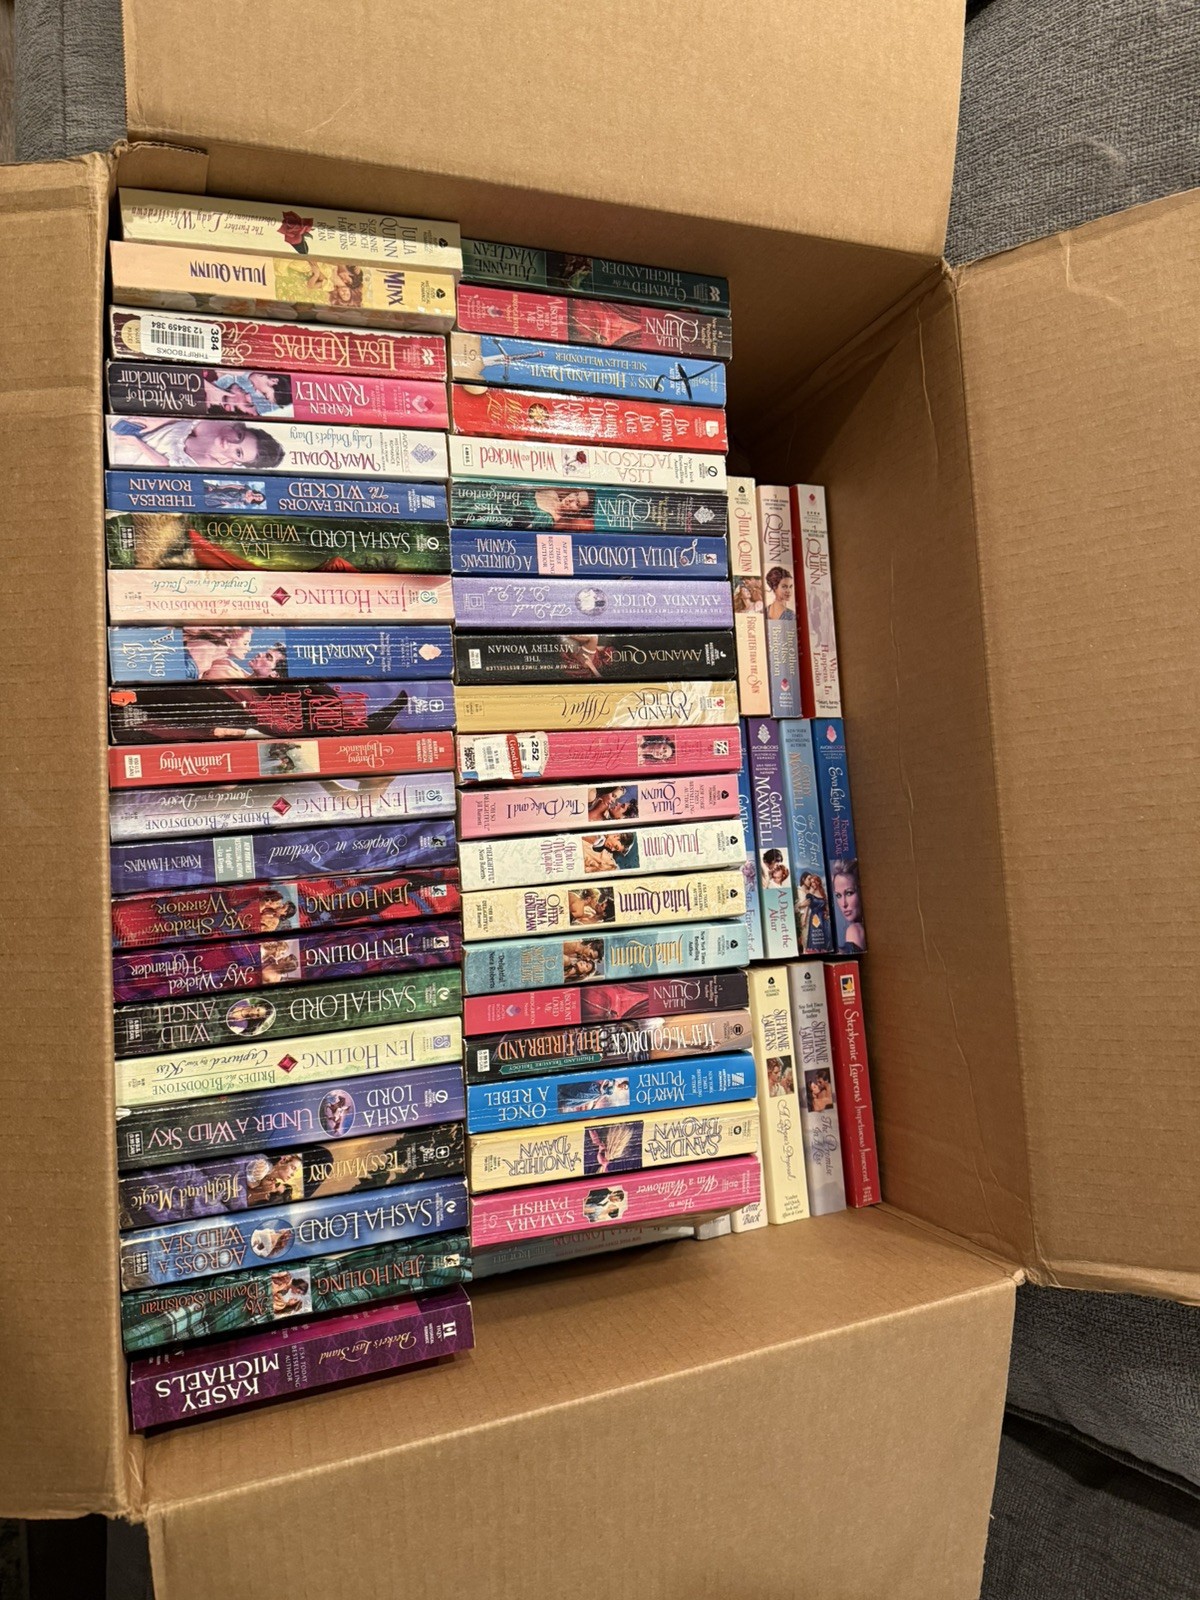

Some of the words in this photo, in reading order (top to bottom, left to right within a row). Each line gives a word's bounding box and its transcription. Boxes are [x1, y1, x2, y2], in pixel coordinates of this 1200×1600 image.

[360, 224, 368, 248] ENOCH
[369, 219, 377, 253] SUZANNE
[189, 261, 231, 279] QUINN
[233, 262, 267, 287] JULIA
[384, 270, 404, 306] MINX
[151, 321, 167, 329] 384
[168, 323, 192, 333] 38459
[210, 328, 219, 351] 384
[156, 347, 209, 359] THRIFTBOOKS
[272, 334, 356, 368] KLEYPAS
[359, 338, 396, 370] LISA
[554, 352, 605, 367] WELFONDER
[605, 357, 647, 371] SUE-ELLEN
[117, 370, 164, 388] Sinclair
[165, 372, 201, 389] Clan
[126, 388, 137, 401] of
[139, 390, 183, 409] Witch
[180, 393, 197, 406] The
[295, 380, 369, 405] RANNEY
[310, 403, 353, 416] KAREN
[289, 428, 314, 445] Diary
[315, 429, 351, 447] Bridget's
[352, 430, 373, 448] Lady
[289, 450, 340, 469] RODALE
[339, 452, 380, 471] MAYA
[594, 450, 673, 471] JACKSON
[129, 478, 192, 492] ROMAIN
[618, 467, 653, 484] LISA
[288, 481, 361, 499] WICKED
[367, 485, 386, 500] The
[458, 488, 522, 502] Bridgerton
[128, 493, 195, 507] THERESA
[278, 498, 335, 511] FAVORS
[336, 500, 400, 514] FORTUNE
[474, 502, 502, 514] Miss
[465, 515, 475, 524] of
[476, 515, 514, 527] Because
[207, 521, 257, 540] WOOD
[261, 523, 300, 542] WILD
[309, 529, 357, 551] LORD
[240, 543, 250, 555] A
[359, 530, 410, 551] SASHA
[474, 537, 517, 554] SCANDAL
[254, 543, 270, 558] IN
[578, 545, 638, 568] LONDON
[642, 545, 680, 569] JULIA
[460, 553, 523, 573] COURTESAN'S
[523, 555, 533, 568] A
[294, 587, 371, 614] HOLLING
[377, 582, 408, 612] JEN
[293, 645, 327, 664] HILL
[327, 643, 377, 665] SANDRA
[487, 643, 528, 654] WOMAN
[531, 643, 575, 653] MYSTERY
[605, 644, 647, 665] QUICK
[648, 648, 703, 662] AMANDA
[813, 652, 822, 687] London
[819, 644, 829, 684] Happens
[824, 685, 832, 696] In
[828, 657, 836, 682] What
[632, 688, 687, 709] QUICK
[551, 694, 611, 726] Affair
[627, 702, 694, 722] AMANDA
[507, 739, 520, 778] Goodwill
[532, 741, 540, 761] 252
[159, 751, 201, 774] Wittig
[197, 752, 231, 775] Laurin
[641, 782, 676, 800] QUINN
[506, 803, 512, 818] I
[513, 803, 529, 814] and
[529, 796, 564, 820] Duke
[565, 797, 584, 815] The
[651, 797, 684, 815] JULIA
[754, 776, 773, 846] MAXWELL
[769, 791, 783, 830] CATHY
[269, 843, 330, 864] Scotland
[335, 841, 347, 853] in
[350, 835, 407, 857] Sleepless
[619, 889, 661, 915] Quinn
[661, 882, 692, 913] Julia
[778, 890, 787, 898] A
[523, 891, 537, 932] GENTLEMAN
[546, 894, 560, 927] OFFER
[558, 906, 564, 915] AN
[768, 908, 779, 932] Altar
[778, 900, 789, 922] Date
[782, 924, 789, 932] at
[782, 934, 791, 948] the
[155, 1000, 216, 1024] ANGEL
[159, 1022, 211, 1045] WILD
[578, 1030, 604, 1051] THE
[690, 1022, 715, 1046] MAY
[844, 1008, 859, 1061] Stephanie
[497, 1033, 575, 1060] FIREBRAND
[508, 1063, 533, 1072] TRILOGY
[535, 1059, 563, 1069] TREASURE
[564, 1055, 595, 1064] HIGHLAND
[636, 1070, 685, 1089] PUTNEY
[848, 1063, 864, 1103] Laurens
[484, 1088, 533, 1103] REBEL
[538, 1085, 550, 1098] A
[636, 1087, 656, 1104] JO
[656, 1084, 685, 1102] MARY
[256, 1107, 314, 1132] UNDER
[498, 1103, 547, 1121] ONCE
[188, 1120, 237, 1143] WILD
[236, 1117, 251, 1134] A
[653, 1117, 721, 1141] BROWN
[146, 1126, 183, 1150] SKY
[518, 1135, 568, 1158] DAWN
[644, 1134, 722, 1161] SANDRA
[501, 1151, 582, 1176] ANOTHER
[635, 1179, 688, 1197] Wallflower
[688, 1177, 694, 1185] a
[695, 1175, 719, 1192] Win
[512, 1197, 569, 1216] PARISH
[668, 1201, 676, 1209] to
[677, 1197, 695, 1211] How
[506, 1210, 576, 1233] SAMARA
[160, 1233, 194, 1252] SEA
[196, 1226, 245, 1248] WILD
[158, 1259, 170, 1271] A
[174, 1246, 248, 1276] ACROSS
[155, 1352, 279, 1398] MICHAELS
[285, 1355, 293, 1382] AUTHOR
[291, 1345, 301, 1388] BESTSELLING
[181, 1378, 260, 1412] KASEY
